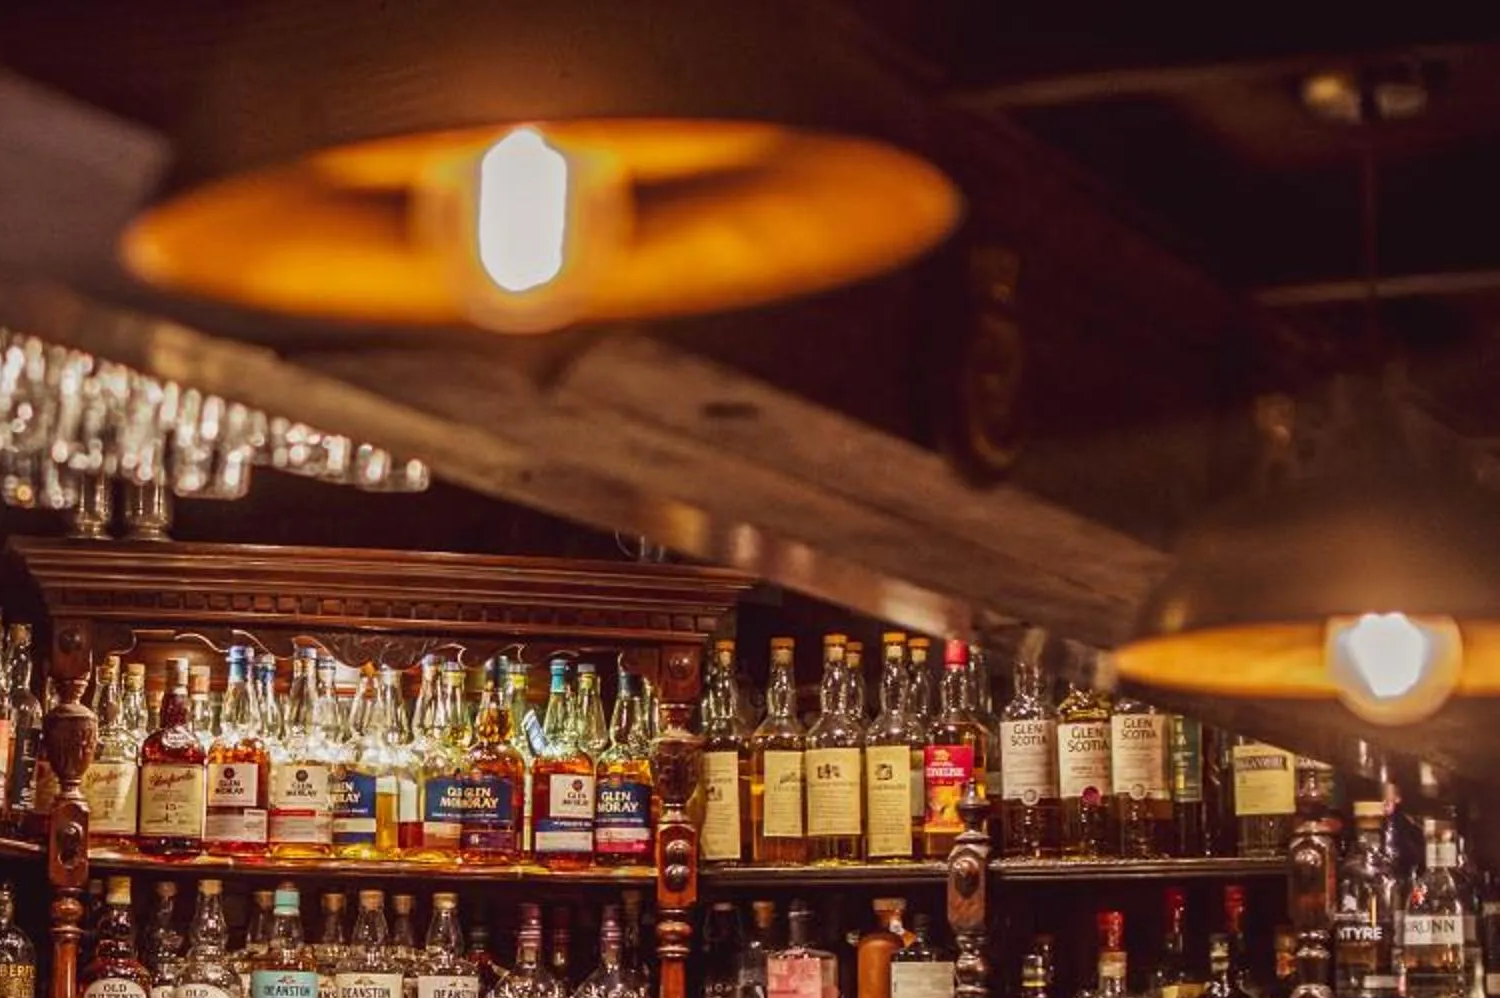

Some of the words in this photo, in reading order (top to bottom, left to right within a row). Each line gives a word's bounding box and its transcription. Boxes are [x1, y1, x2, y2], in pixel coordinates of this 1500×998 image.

[1124, 718, 1153, 728] GLEN
[1013, 723, 1042, 735] GLEN
[1071, 726, 1103, 739] GLEN
[1121, 729, 1156, 741] SCOTIA
[1011, 735, 1047, 747] SCOTIA
[1067, 740, 1110, 753] SCOTIA
[601, 791, 632, 802] GLEN
[597, 802, 640, 813] MORAY
[103, 983, 127, 993] OLD
[185, 989, 209, 998] OLD
[264, 985, 311, 997] DEANSTON
[341, 987, 392, 998] DEANSTON
